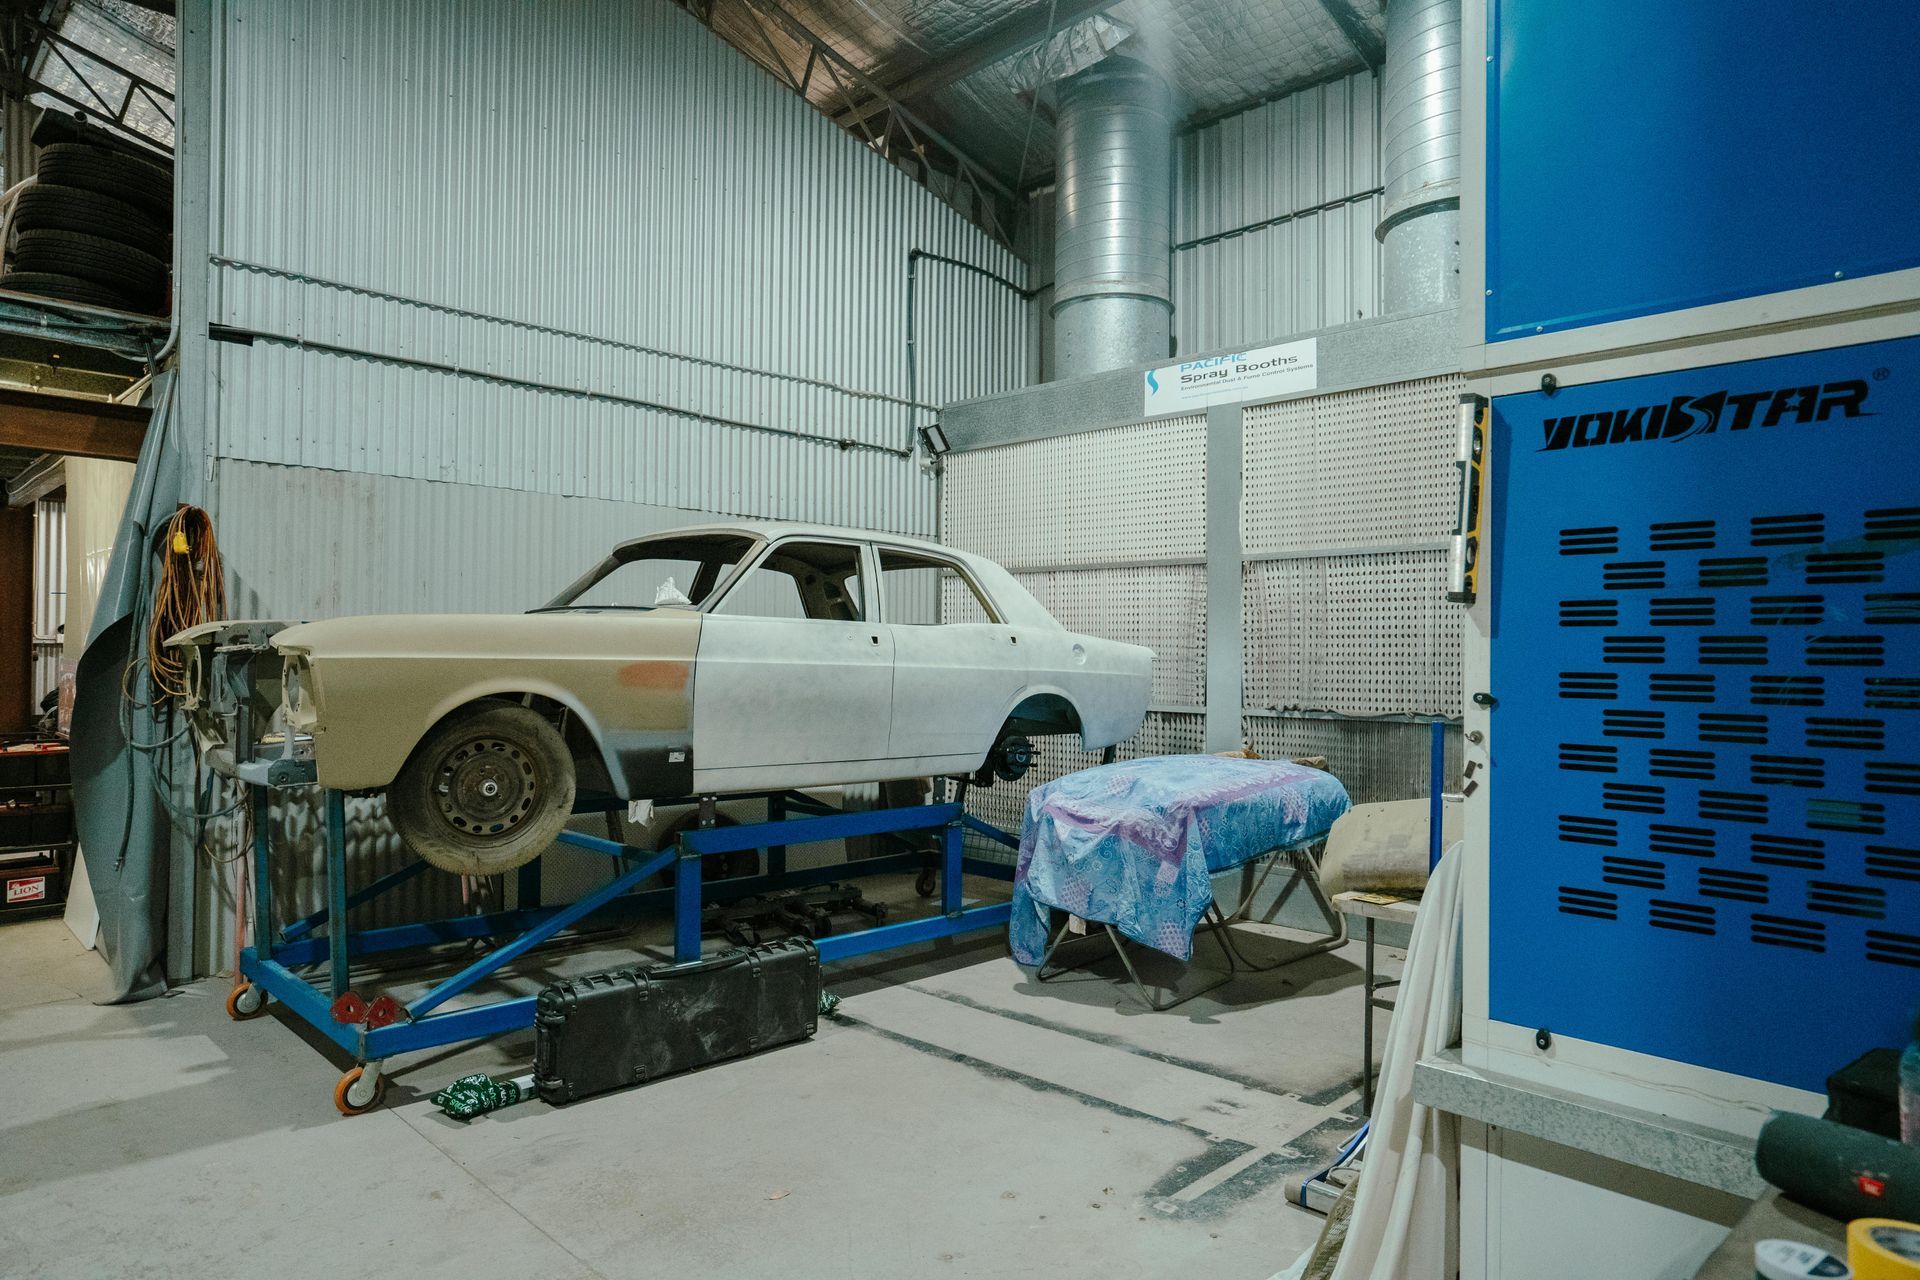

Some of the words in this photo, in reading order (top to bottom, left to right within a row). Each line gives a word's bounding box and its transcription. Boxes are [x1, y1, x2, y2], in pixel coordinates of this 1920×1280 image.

[1180, 353, 1247, 373] PACIFIC
[1180, 368, 1228, 384] Spray
[1235, 355, 1298, 373] Booths
[1180, 380, 1221, 391] Environmental
[1261, 369, 1285, 377] Control
[1286, 363, 1314, 373] Systems
[13, 884, 39, 896] LION
